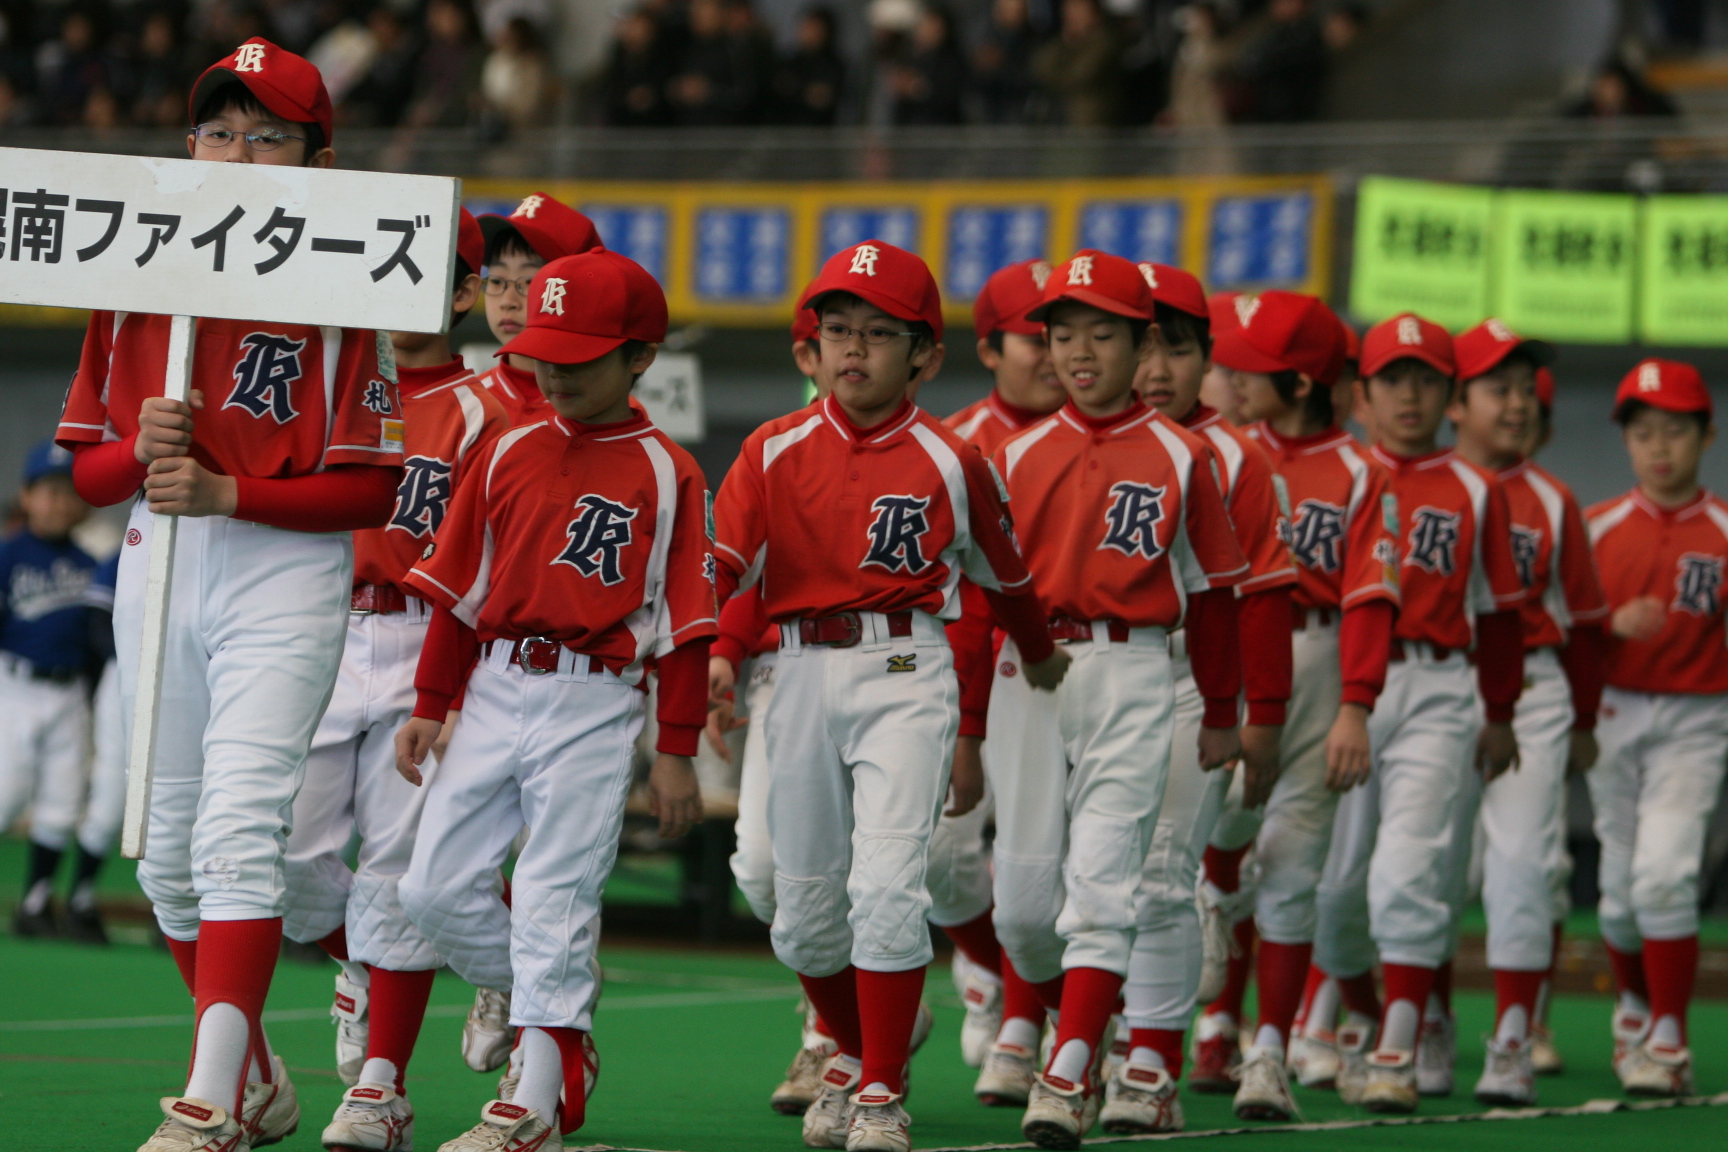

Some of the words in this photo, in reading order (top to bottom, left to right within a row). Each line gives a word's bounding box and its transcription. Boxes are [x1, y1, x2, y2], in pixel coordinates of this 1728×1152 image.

[0, 187, 430, 287] 南ファイターズ
